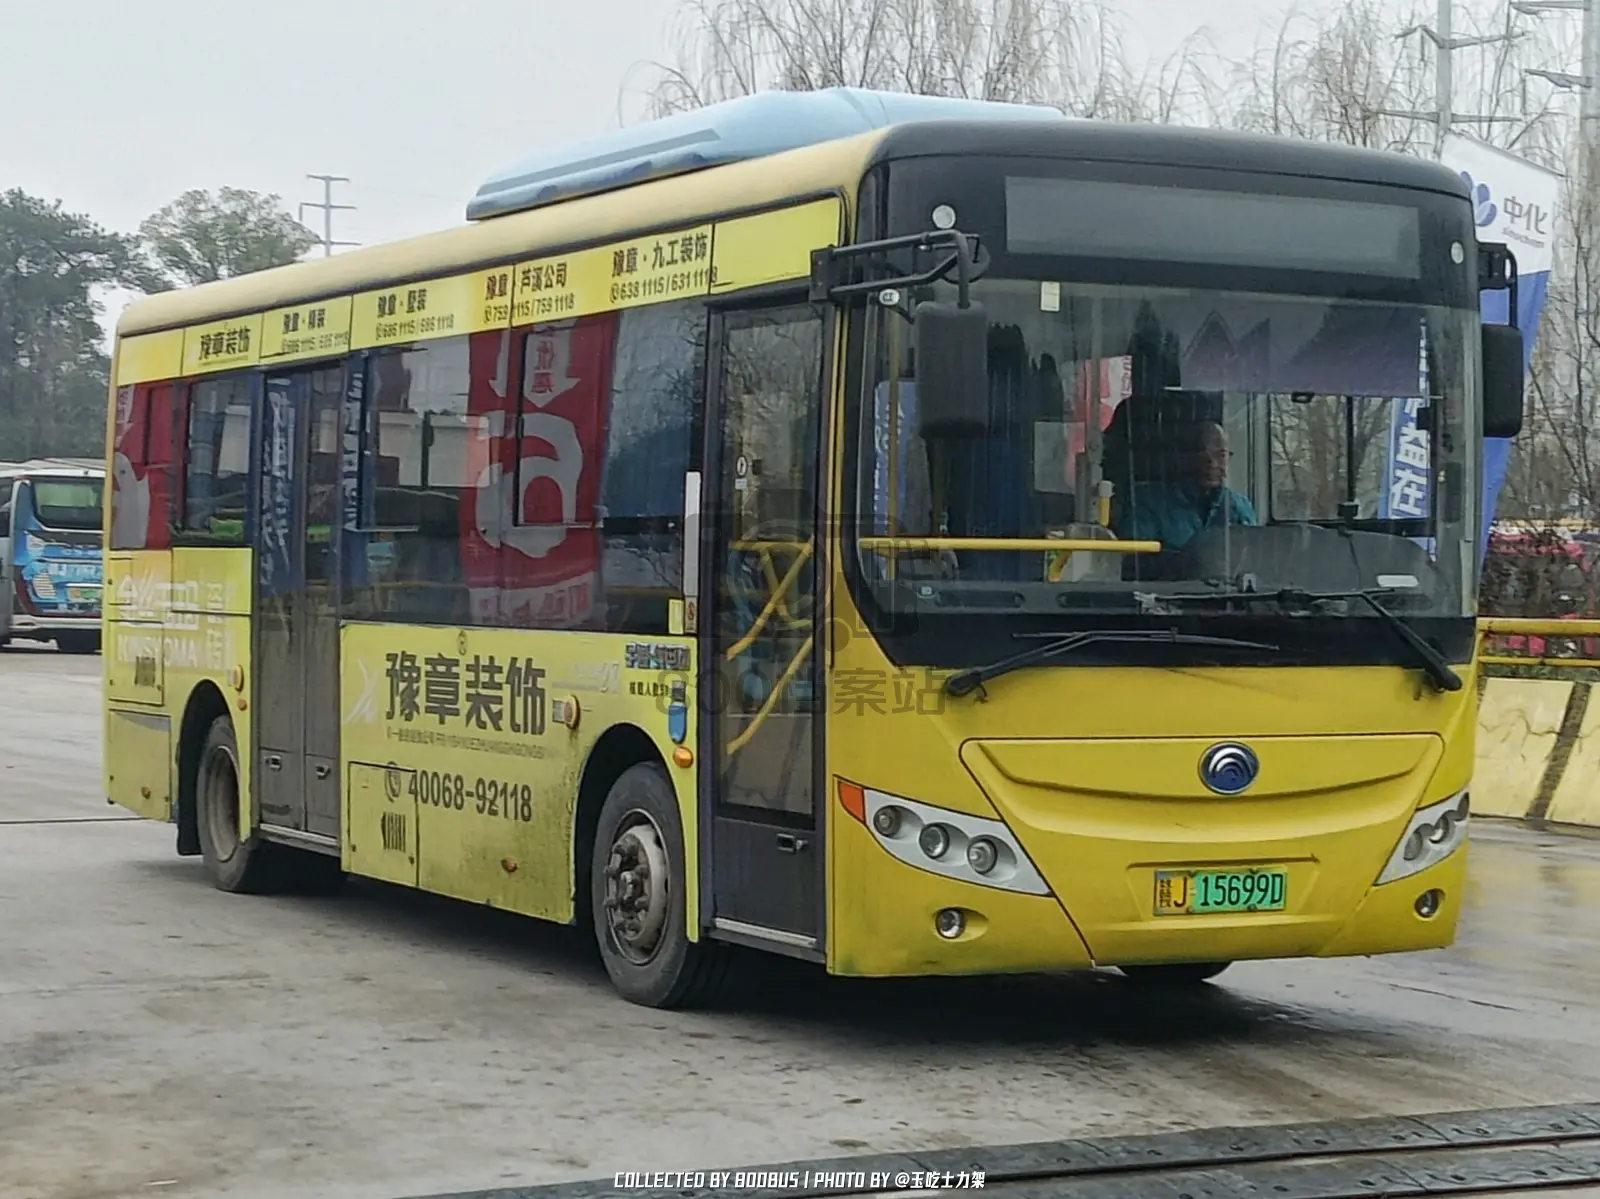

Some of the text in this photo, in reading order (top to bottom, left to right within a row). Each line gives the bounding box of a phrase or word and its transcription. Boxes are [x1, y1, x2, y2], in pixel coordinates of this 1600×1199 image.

[1503, 196, 1548, 235] 中化
[198, 325, 251, 360] 豫章装饰
[385, 651, 546, 736] 豫章装饰
[408, 770, 532, 822] 40068-92118
